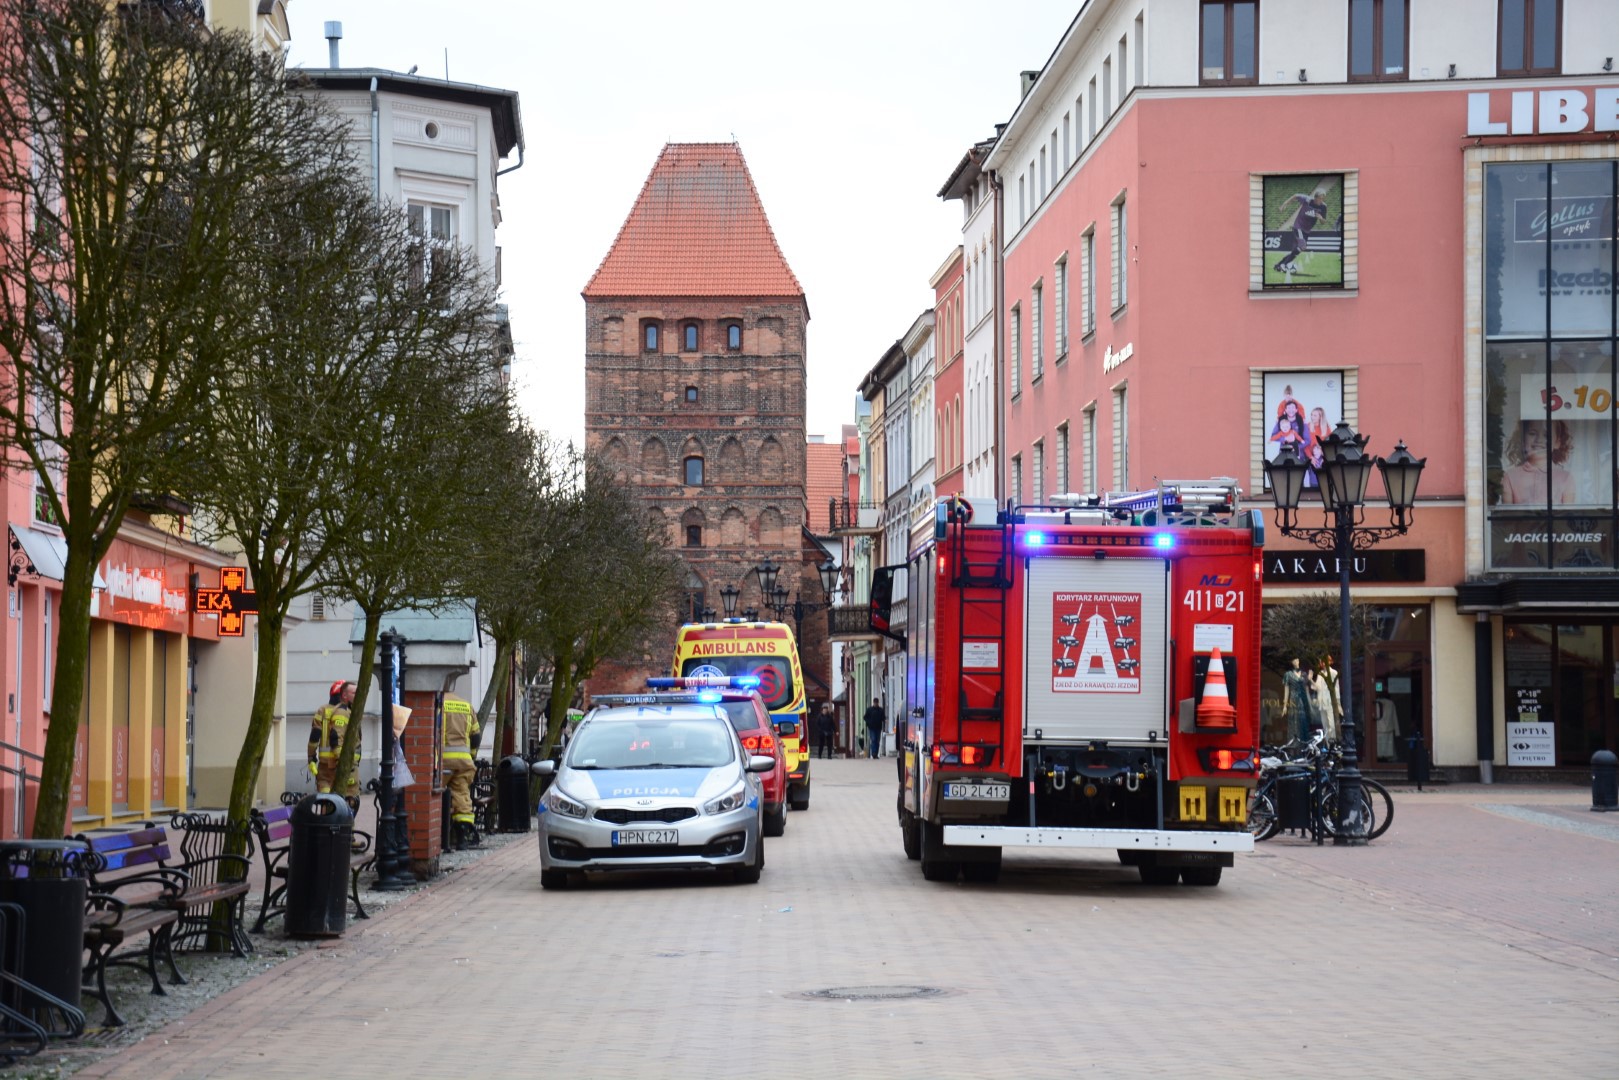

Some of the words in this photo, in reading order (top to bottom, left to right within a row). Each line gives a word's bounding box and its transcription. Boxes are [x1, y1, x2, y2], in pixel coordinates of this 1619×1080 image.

[1264, 234, 1281, 248] as
[1538, 268, 1619, 288] Reeb
[197, 592, 232, 609] EKA
[692, 642, 776, 655] AMBULANS
[1084, 682, 1116, 690] KRAWĘDZI
[613, 787, 680, 796] POLICJA
[951, 785, 967, 797] GD
[971, 785, 1007, 798] 2L413
[620, 832, 644, 844] HPN
[647, 831, 676, 843] C217
